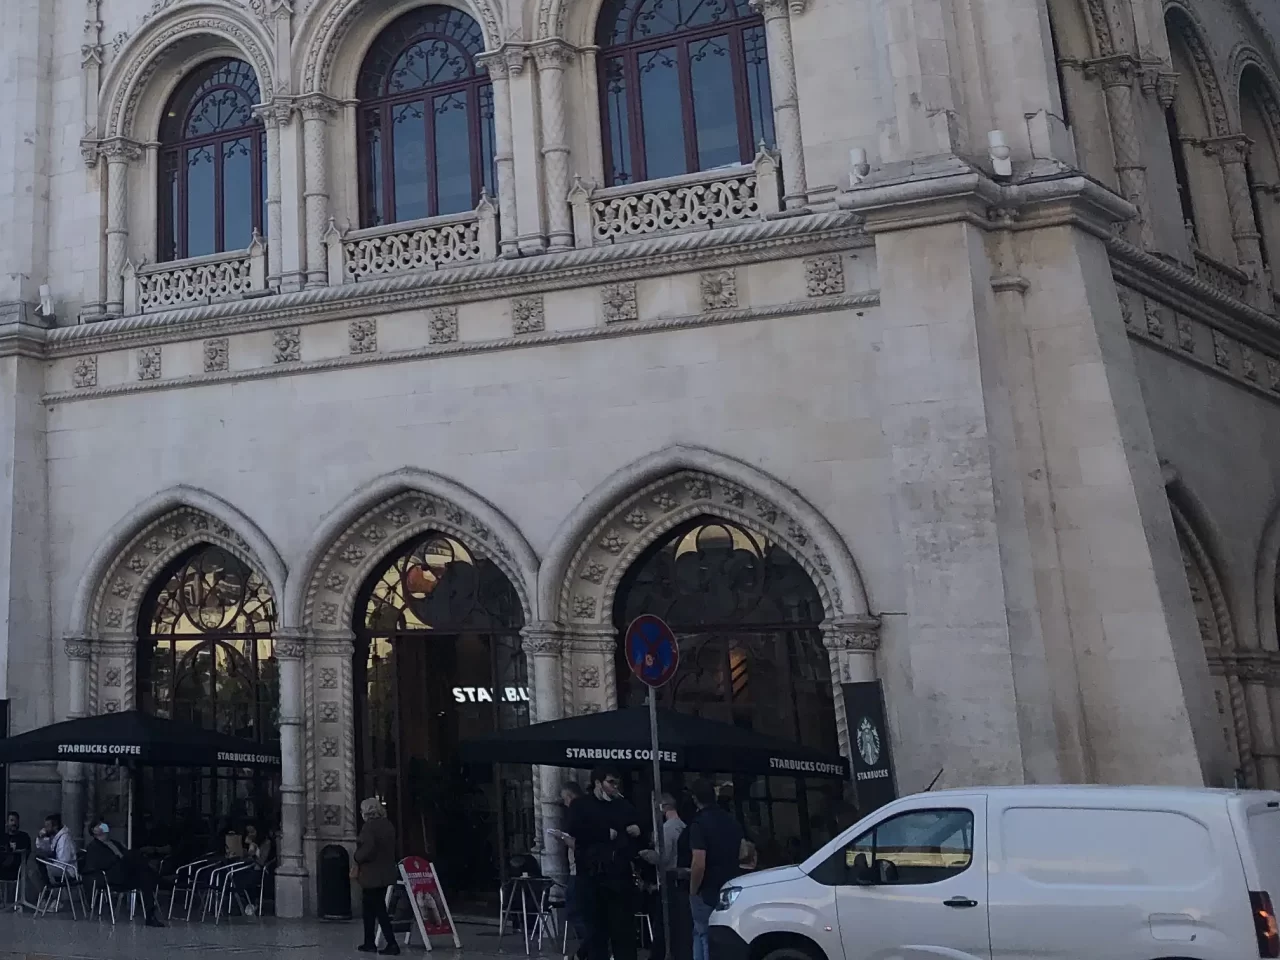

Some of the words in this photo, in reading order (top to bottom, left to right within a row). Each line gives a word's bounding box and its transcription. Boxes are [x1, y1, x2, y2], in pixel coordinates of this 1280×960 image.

[57, 744, 108, 754] STARBUCKS
[108, 744, 141, 755] COFFEE
[565, 747, 632, 760] STARBUCKS
[217, 751, 256, 763] STARBUCKS
[256, 754, 281, 765] COFFEE
[769, 756, 815, 773] STARBUCKS
[816, 761, 844, 776] COFFEE
[856, 768, 889, 781] STARBUCKS
